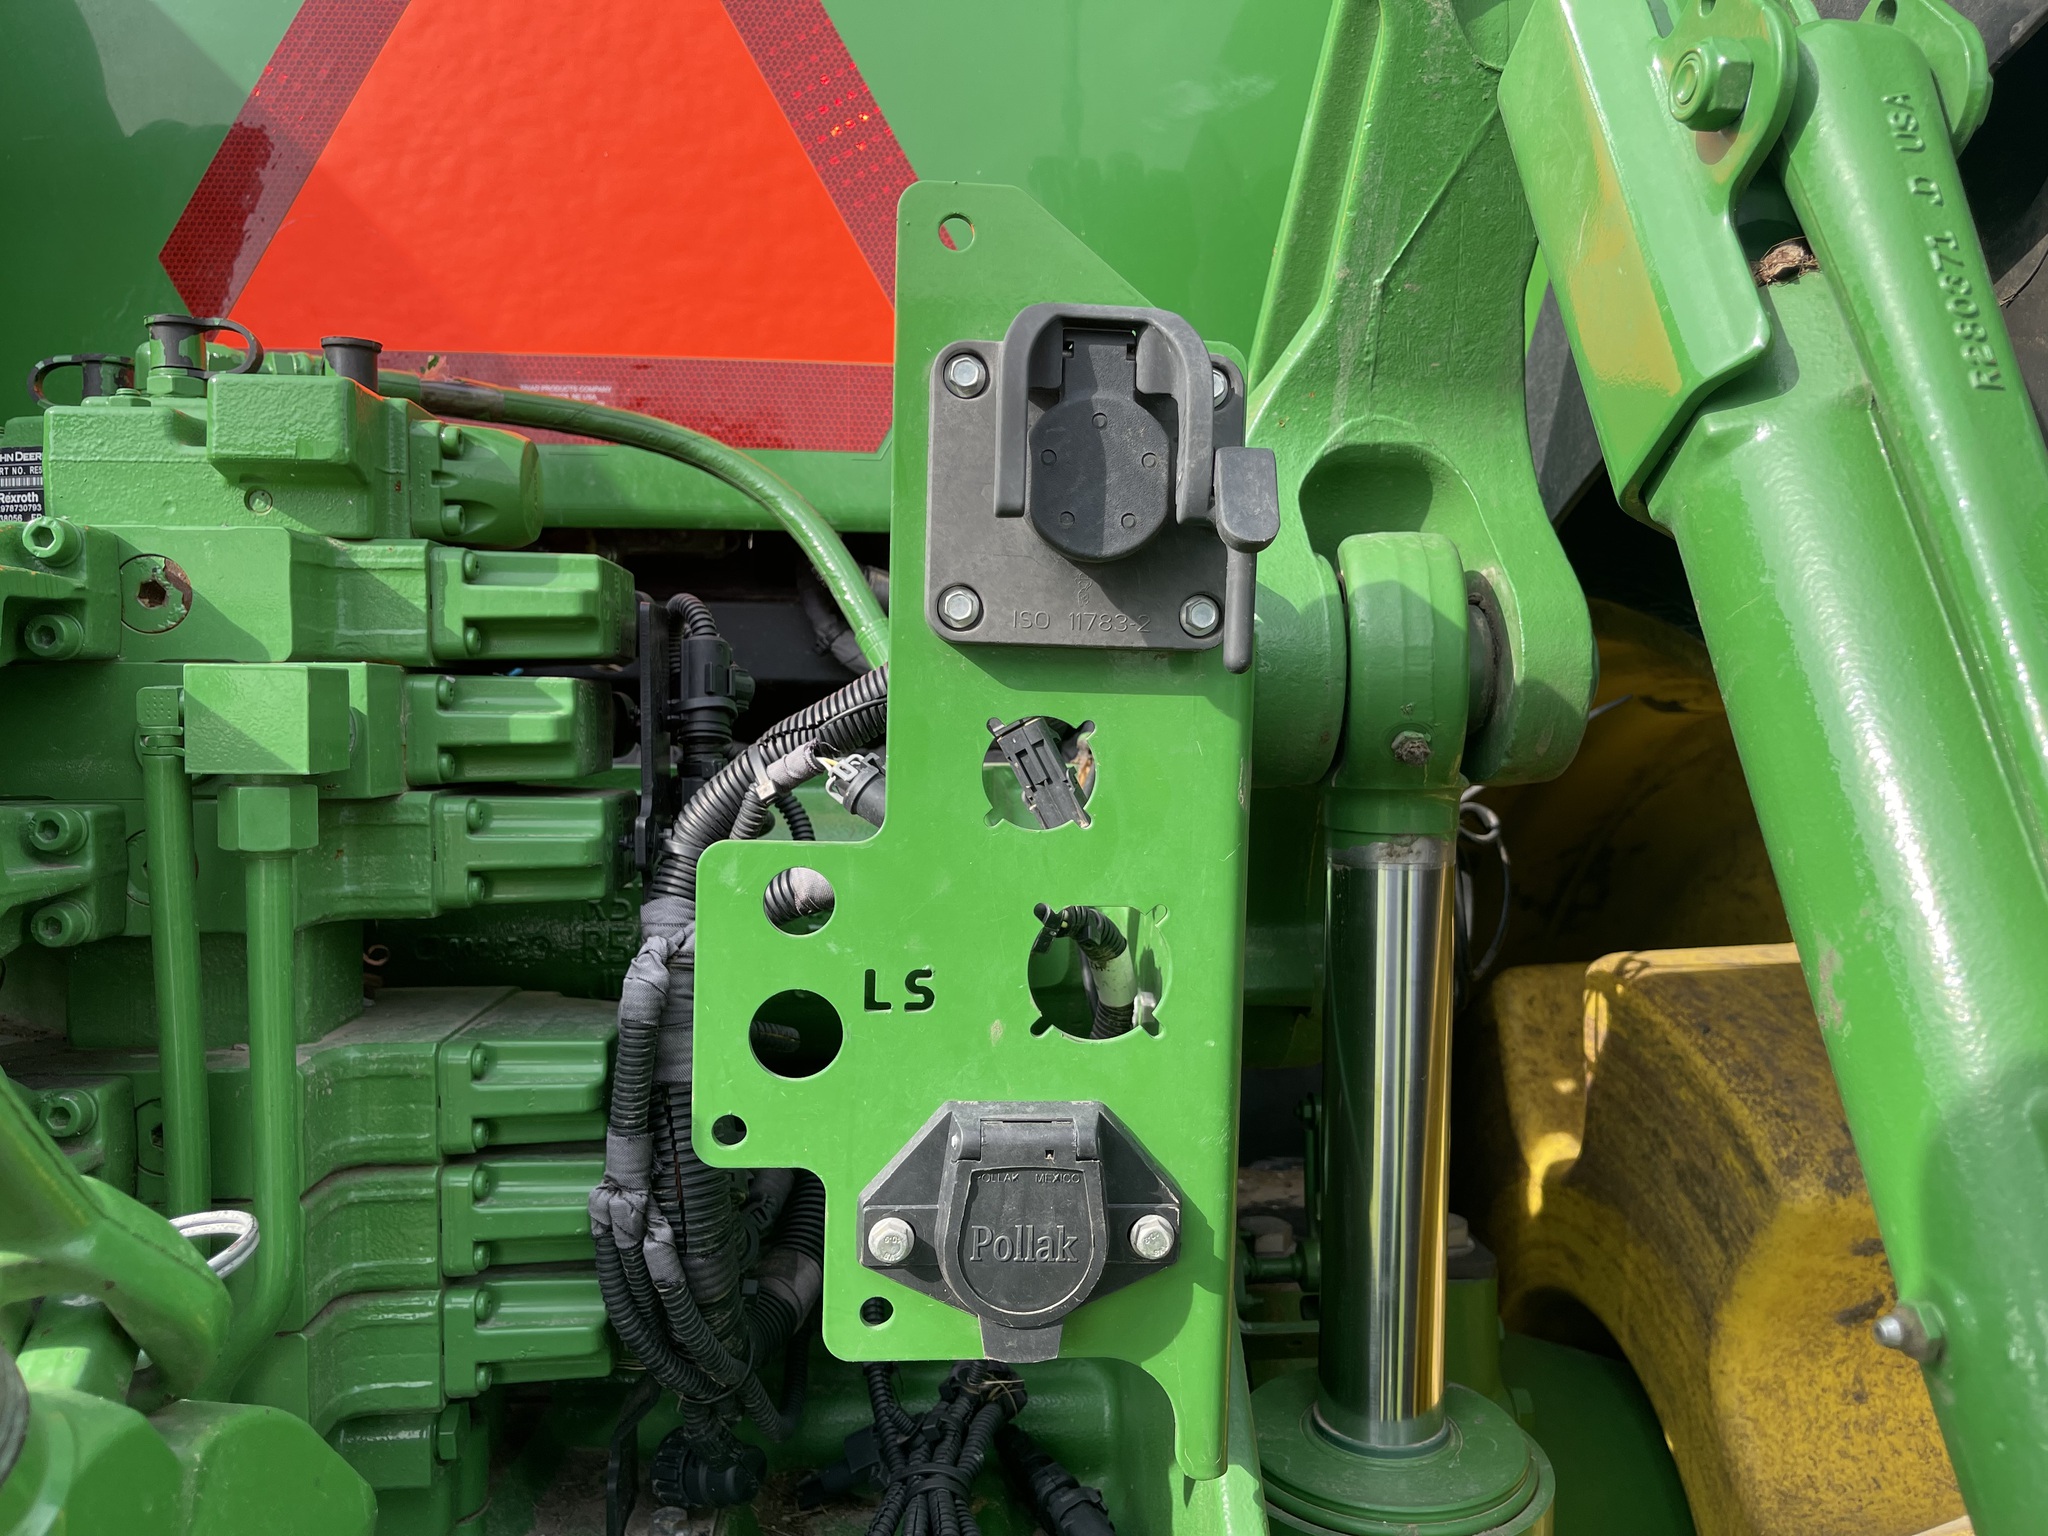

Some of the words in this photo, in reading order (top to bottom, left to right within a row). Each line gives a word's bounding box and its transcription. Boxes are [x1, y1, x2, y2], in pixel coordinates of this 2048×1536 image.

[1881, 92, 1926, 154] USA
[0, 453, 14, 462] HN
[15, 451, 42, 462] DEER
[0, 467, 9, 476] RT
[29, 465, 42, 474] RE5
[0, 503, 42, 513] 978730793
[1012, 610, 1050, 630] ISO
[1069, 611, 1151, 634] 11783-2
[864, 968, 936, 1011] LS
[1034, 1173, 1081, 1183] MEXICO
[969, 1224, 1079, 1263] Pollak
